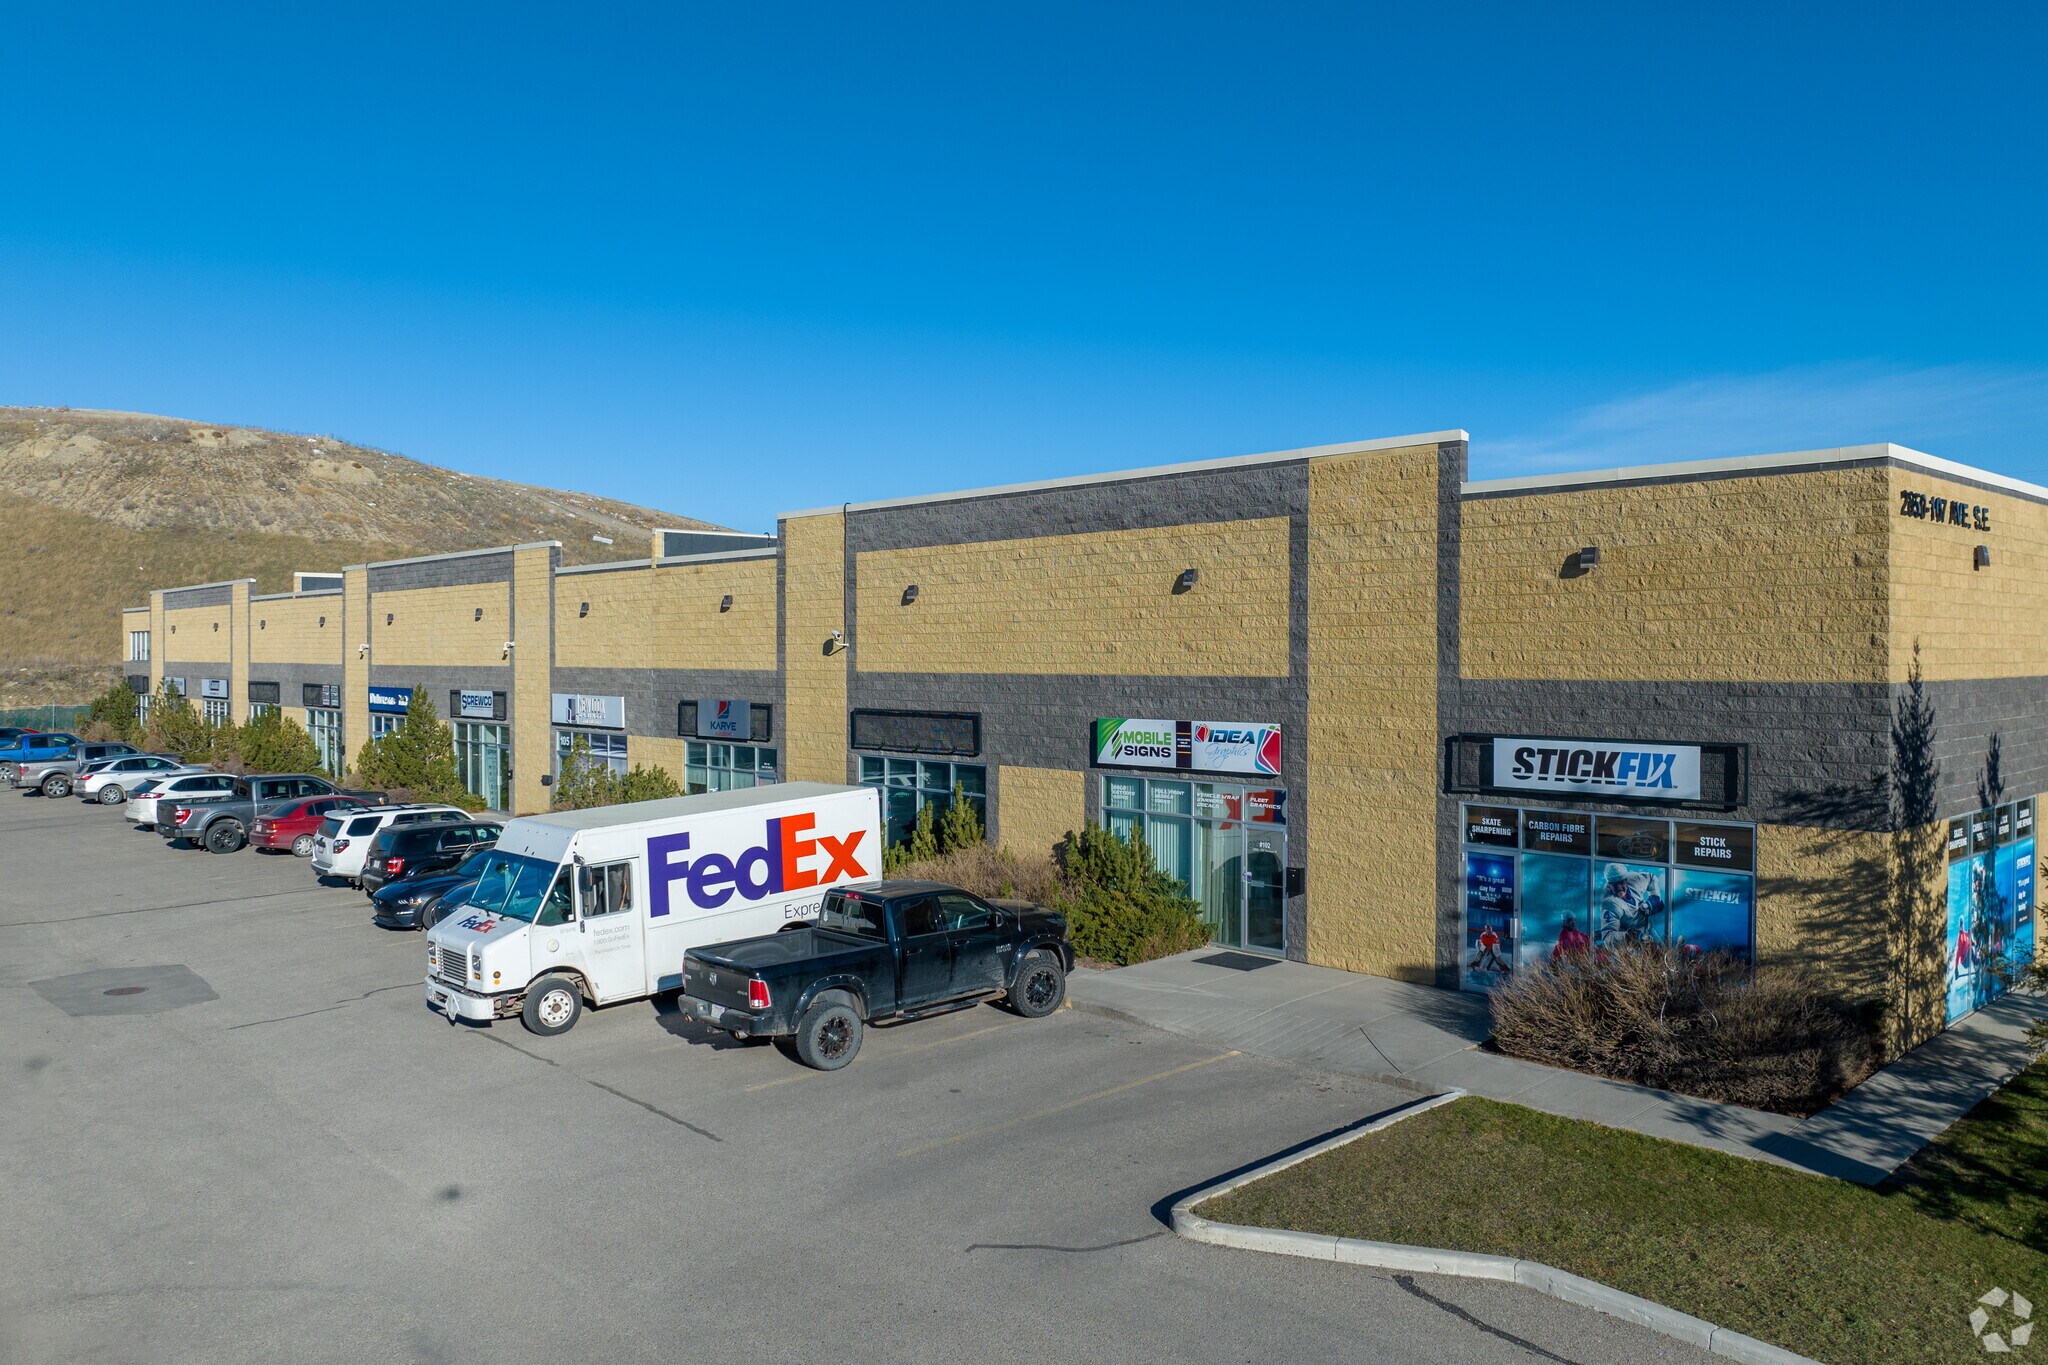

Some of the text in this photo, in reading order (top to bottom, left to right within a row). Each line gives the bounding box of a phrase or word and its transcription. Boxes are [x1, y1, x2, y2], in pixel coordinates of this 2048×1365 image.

[461, 694, 492, 709] SCREWCO
[710, 721, 737, 731] KARVE
[560, 735, 570, 746] 105
[1123, 730, 1172, 746] MOBILE
[1208, 729, 1256, 745] IDEA
[1124, 745, 1172, 758] SIGNS
[1204, 743, 1250, 768] Graphics
[1512, 746, 1677, 789] STICKFIX
[1250, 802, 1282, 810] GRAPHICS
[1481, 817, 1502, 827] SKATE
[1528, 820, 1585, 834] CARBON FIBRE
[1471, 825, 1512, 836] SHARPENING
[1540, 832, 1573, 843] REPAIRS
[1700, 836, 1726, 848] STICK
[1694, 847, 1732, 859] REPAIRS
[647, 811, 869, 919] FedEx
[1685, 887, 1740, 905] STICKFIX
[784, 902, 821, 919] Expre
[1603, 910, 1612, 922] 4
[457, 915, 496, 933] FedEx
[593, 924, 631, 937] fedex.com
